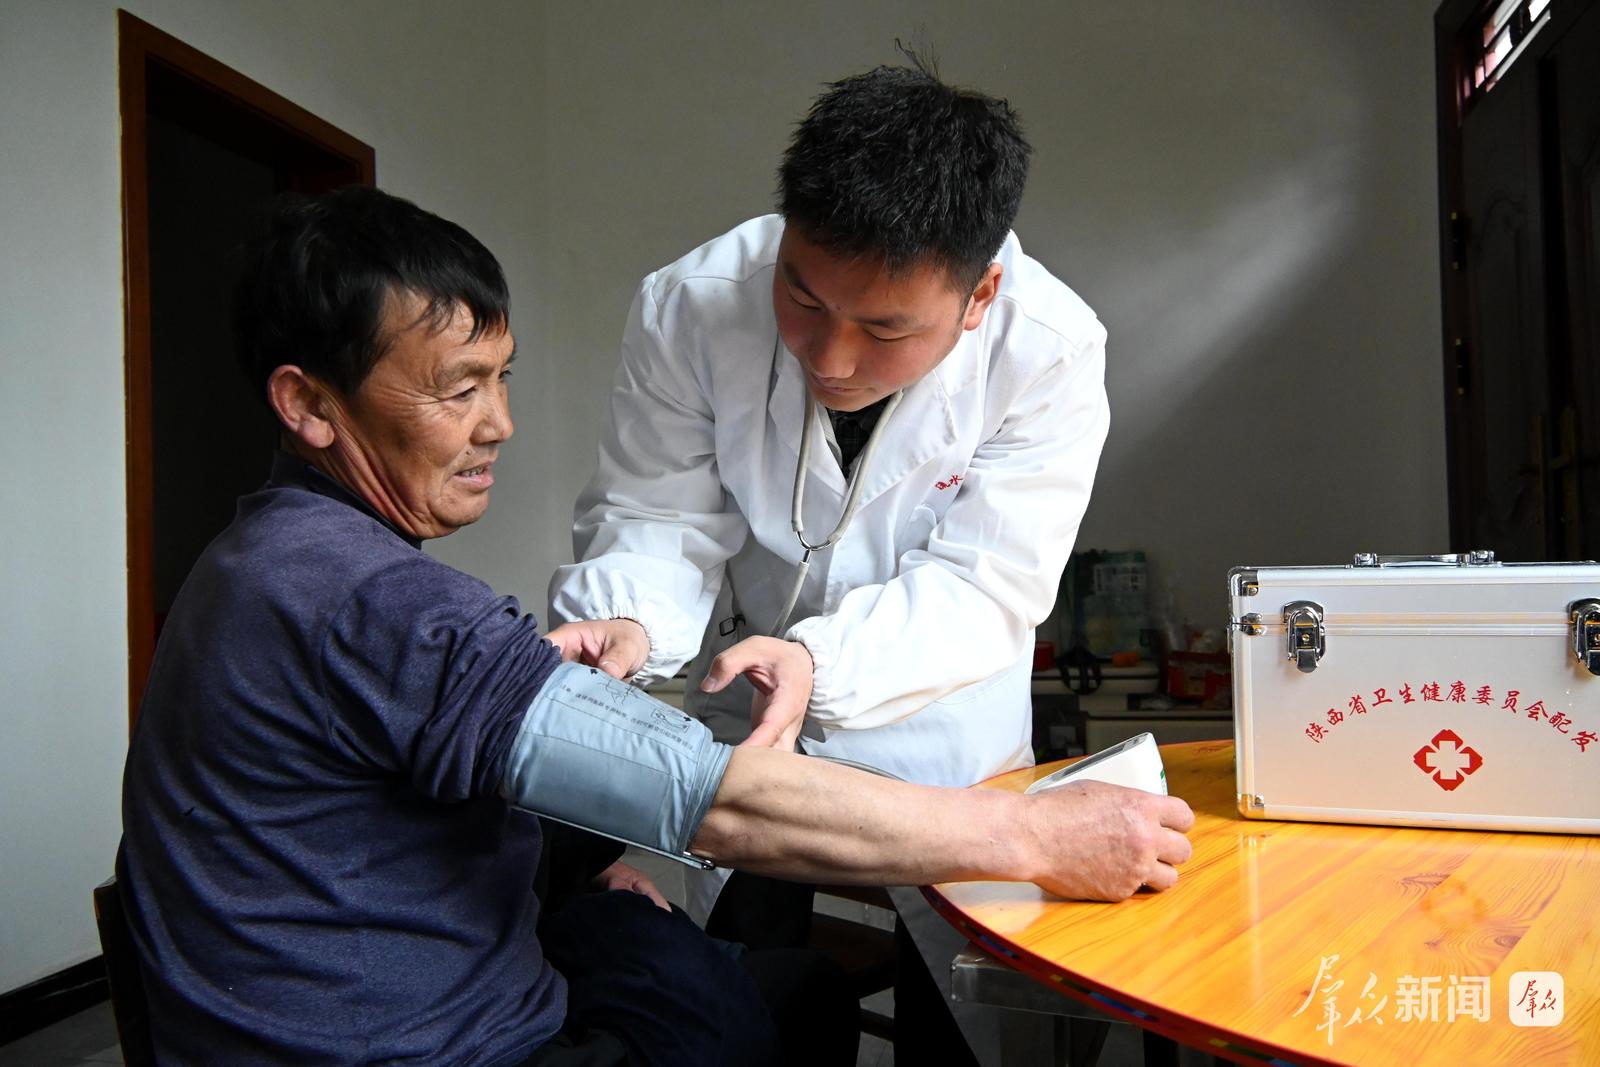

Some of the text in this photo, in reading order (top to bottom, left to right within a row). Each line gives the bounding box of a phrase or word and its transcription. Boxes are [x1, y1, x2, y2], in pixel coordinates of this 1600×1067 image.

[1304, 680, 1599, 752] 陕西省卫生健康委员会配发
